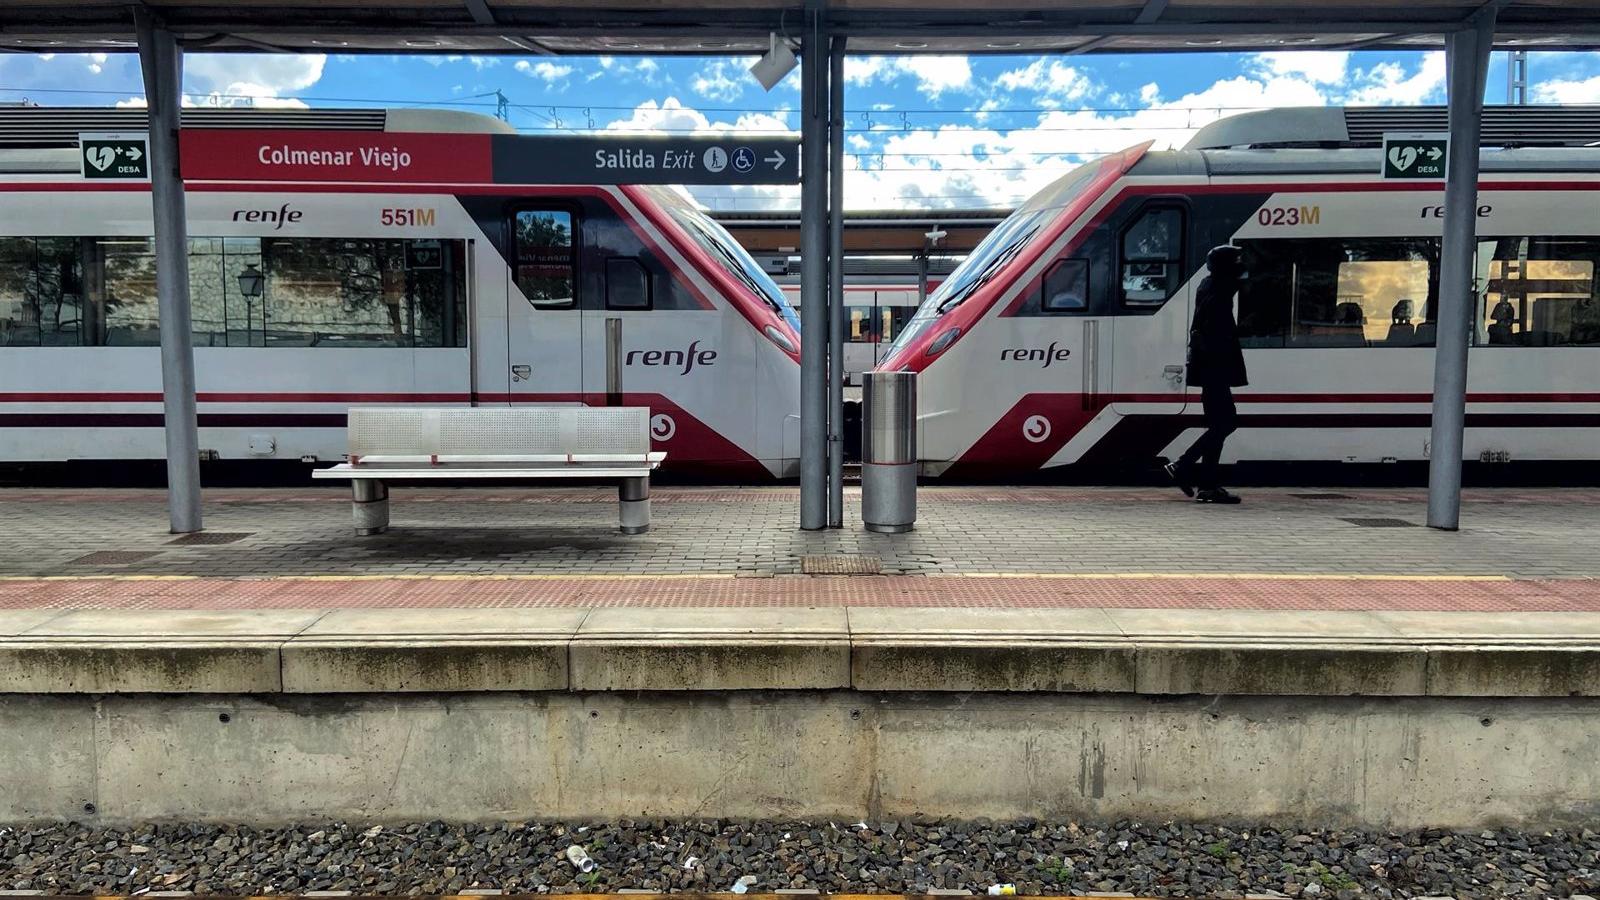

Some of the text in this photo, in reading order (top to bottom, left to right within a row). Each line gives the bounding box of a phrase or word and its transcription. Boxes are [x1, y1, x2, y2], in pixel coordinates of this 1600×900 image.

[258, 145, 412, 171] Colmenar Viejo
[595, 147, 696, 169] Salida Exit
[232, 202, 303, 230] renfe
[381, 208, 435, 226] 551M
[1258, 206, 1320, 226] 023M
[1421, 205, 1492, 218] ree
[625, 340, 718, 376] renfe
[1000, 341, 1071, 368] renfe
